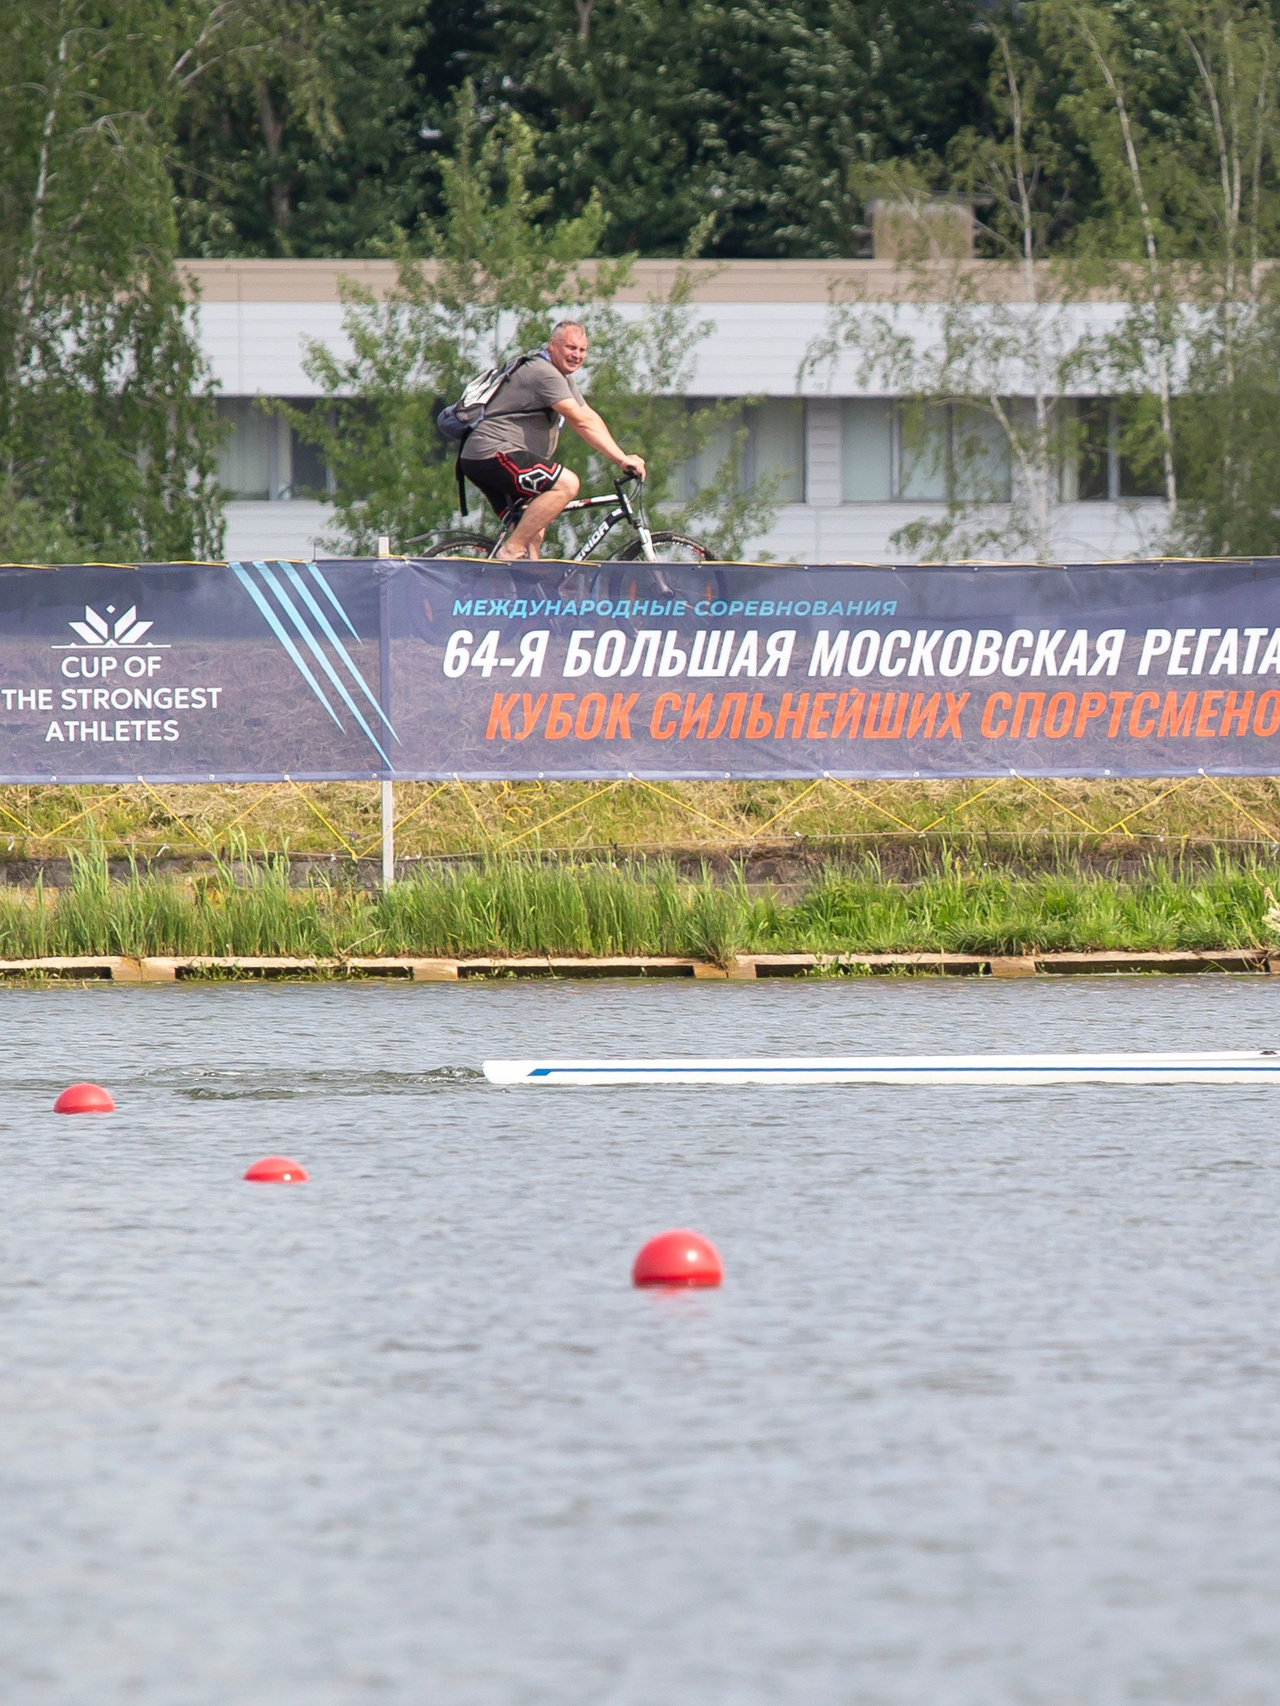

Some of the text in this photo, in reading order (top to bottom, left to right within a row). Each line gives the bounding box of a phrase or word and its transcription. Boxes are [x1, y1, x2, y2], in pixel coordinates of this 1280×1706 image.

[452, 599, 898, 619] МЕЖДУНАРОДНЫЕ СОРЕВНОВАНИЯ
[443, 629, 551, 679] 64-Я
[562, 629, 797, 679] БОЛЬШАЯ
[807, 628, 1127, 678] МОСКОВСКАЯ
[61, 656, 162, 678] CUP OF
[1, 687, 223, 711] THE STRONGEST
[485, 692, 641, 741] КУБОК
[650, 688, 972, 740] СИЛЬНЕЙШИХ
[45, 719, 180, 742] ATHLETES
